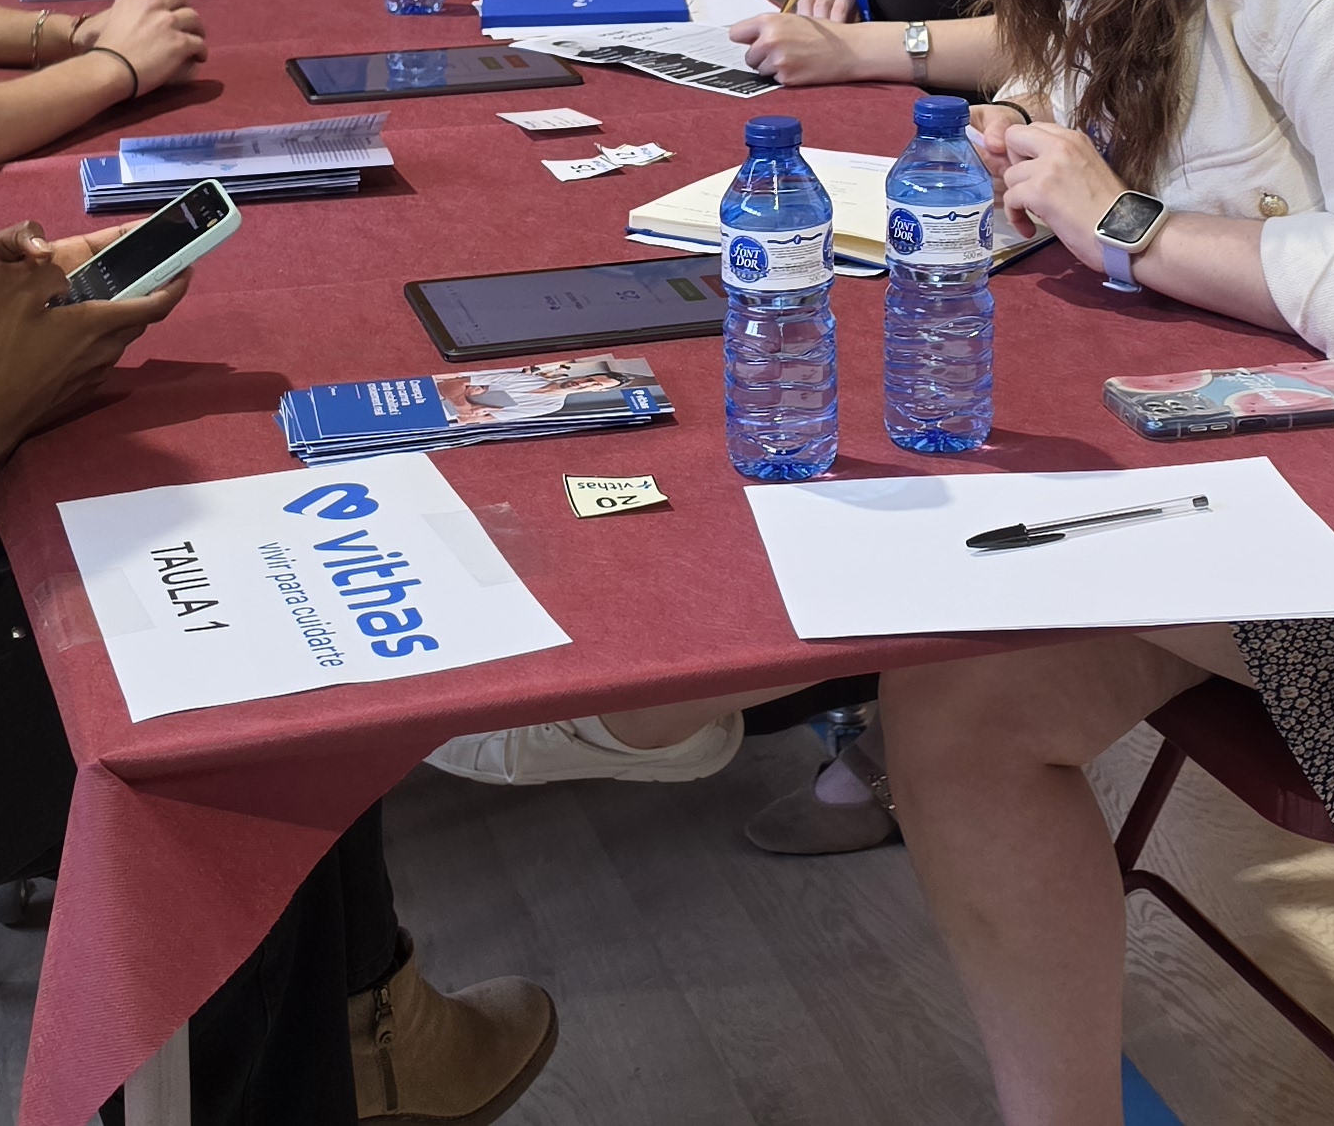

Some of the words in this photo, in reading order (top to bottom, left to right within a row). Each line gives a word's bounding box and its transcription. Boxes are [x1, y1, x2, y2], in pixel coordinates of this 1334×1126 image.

[963, 251, 976, 261] 500
[577, 482, 634, 491] vithas
[596, 495, 641, 509] 20
[257, 541, 297, 569] vivir
[150, 541, 219, 617] TAULA
[264, 572, 309, 605] para
[312, 529, 440, 658] vithas
[183, 621, 230, 632] 1
[291, 606, 346, 668] cuidarte
